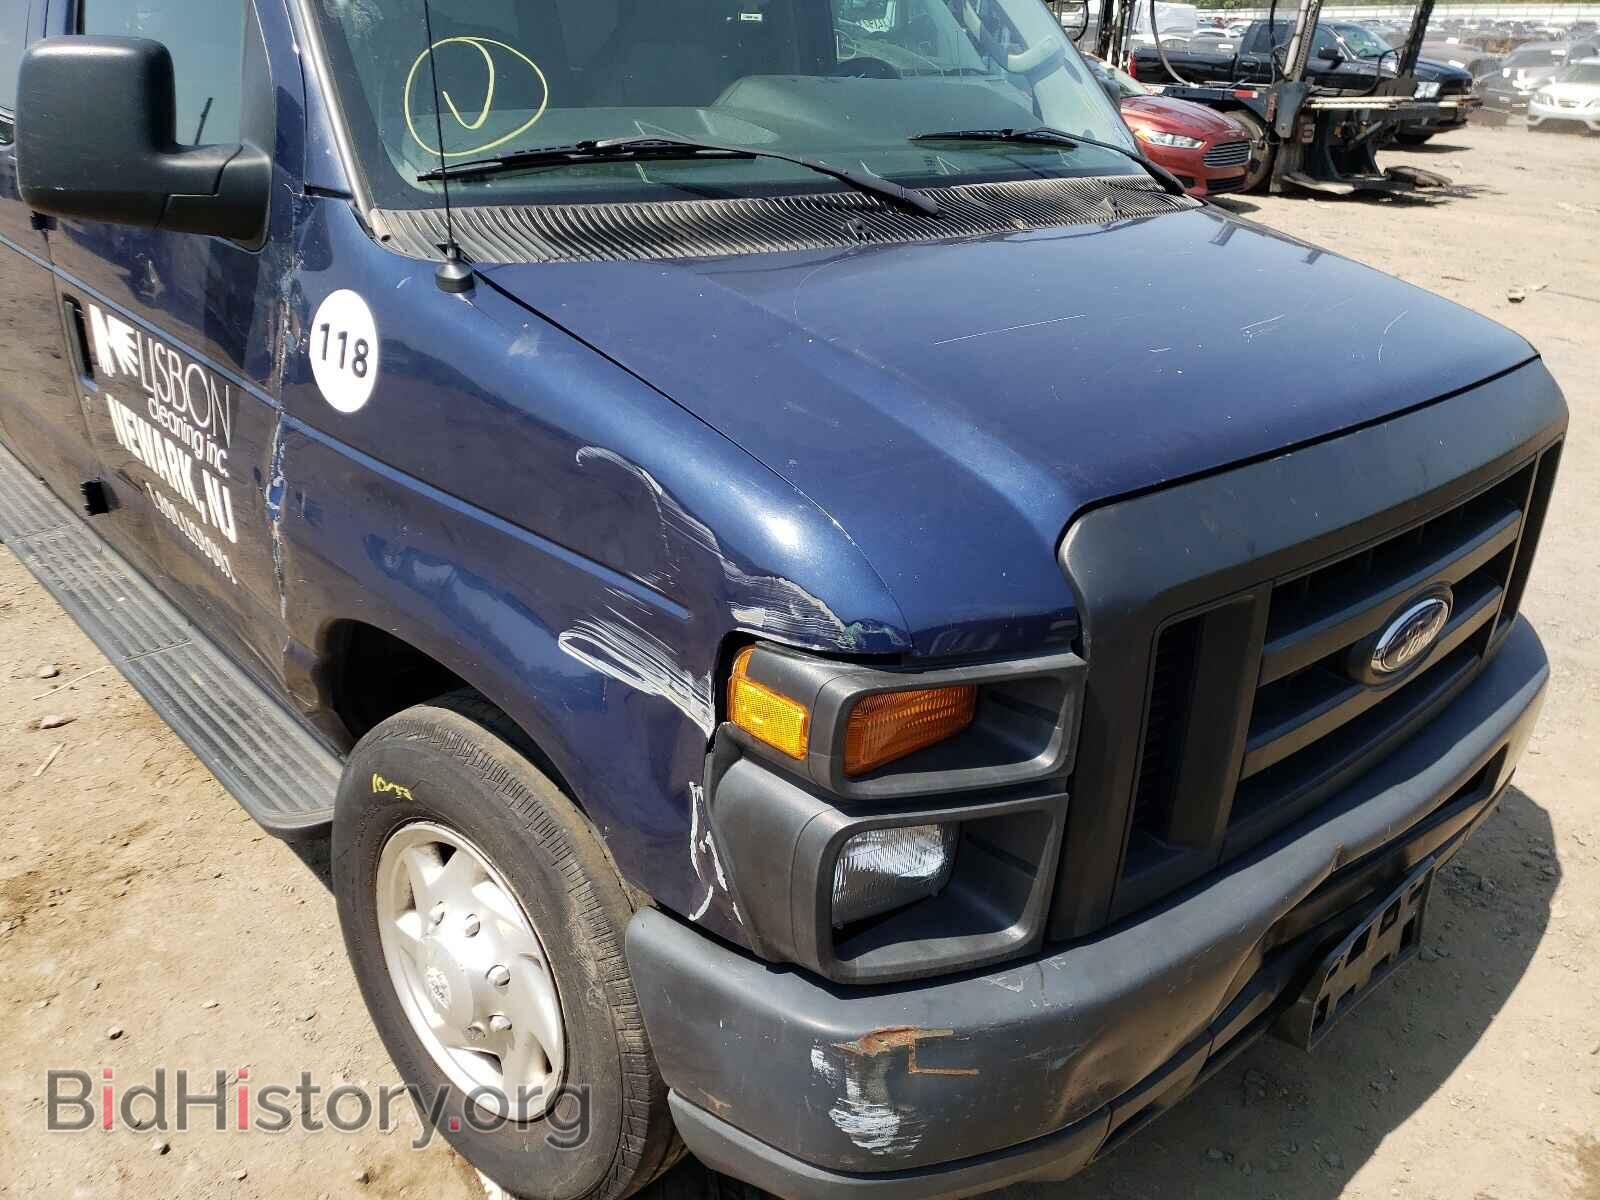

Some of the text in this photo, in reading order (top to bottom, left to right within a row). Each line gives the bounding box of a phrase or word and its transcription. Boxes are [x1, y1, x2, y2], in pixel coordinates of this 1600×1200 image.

[137, 331, 231, 448] LISBON
[319, 323, 370, 378] 118
[105, 392, 207, 525] NEWARK,
[202, 469, 237, 543] NJ
[148, 397, 230, 478] cleaning inc.
